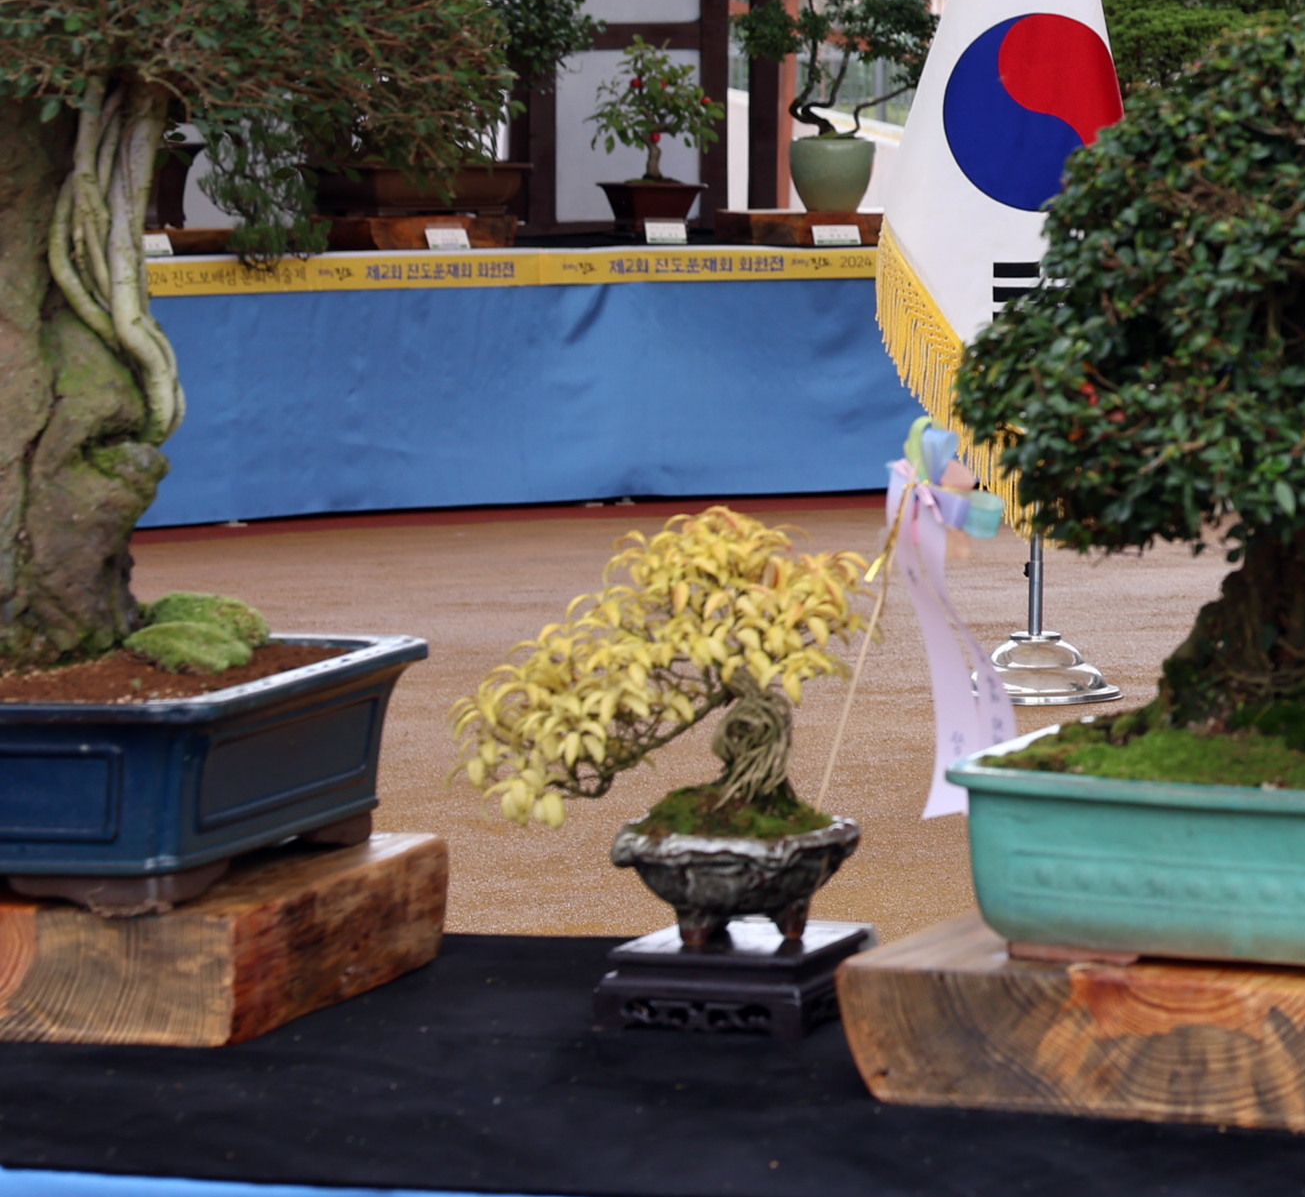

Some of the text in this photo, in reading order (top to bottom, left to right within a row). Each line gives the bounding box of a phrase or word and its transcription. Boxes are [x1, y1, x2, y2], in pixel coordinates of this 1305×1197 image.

[366, 263, 403, 280] 제2회
[477, 261, 515, 278] 회원전
[609, 258, 649, 274] 제2회
[739, 256, 785, 272] 회원전
[841, 257, 873, 269] 2024
[147, 271, 168, 285] 024
